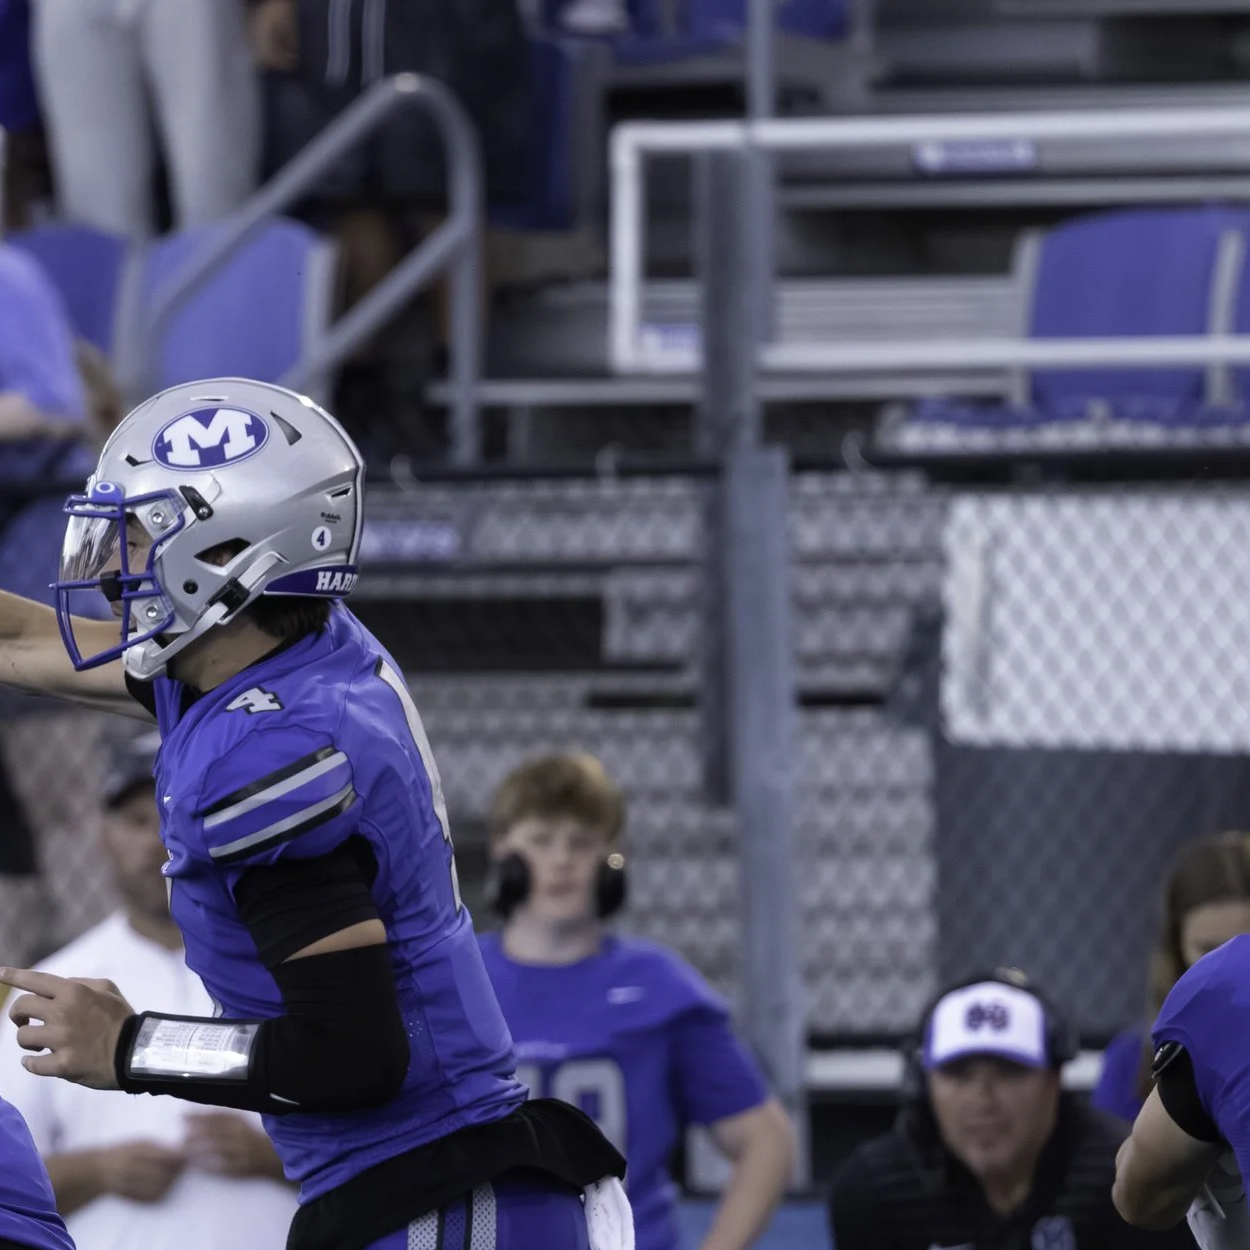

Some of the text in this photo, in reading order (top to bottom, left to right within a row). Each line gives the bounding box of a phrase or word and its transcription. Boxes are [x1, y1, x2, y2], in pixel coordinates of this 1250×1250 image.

[162, 408, 256, 466] M
[316, 529, 326, 547] 4
[224, 685, 284, 714] 4
